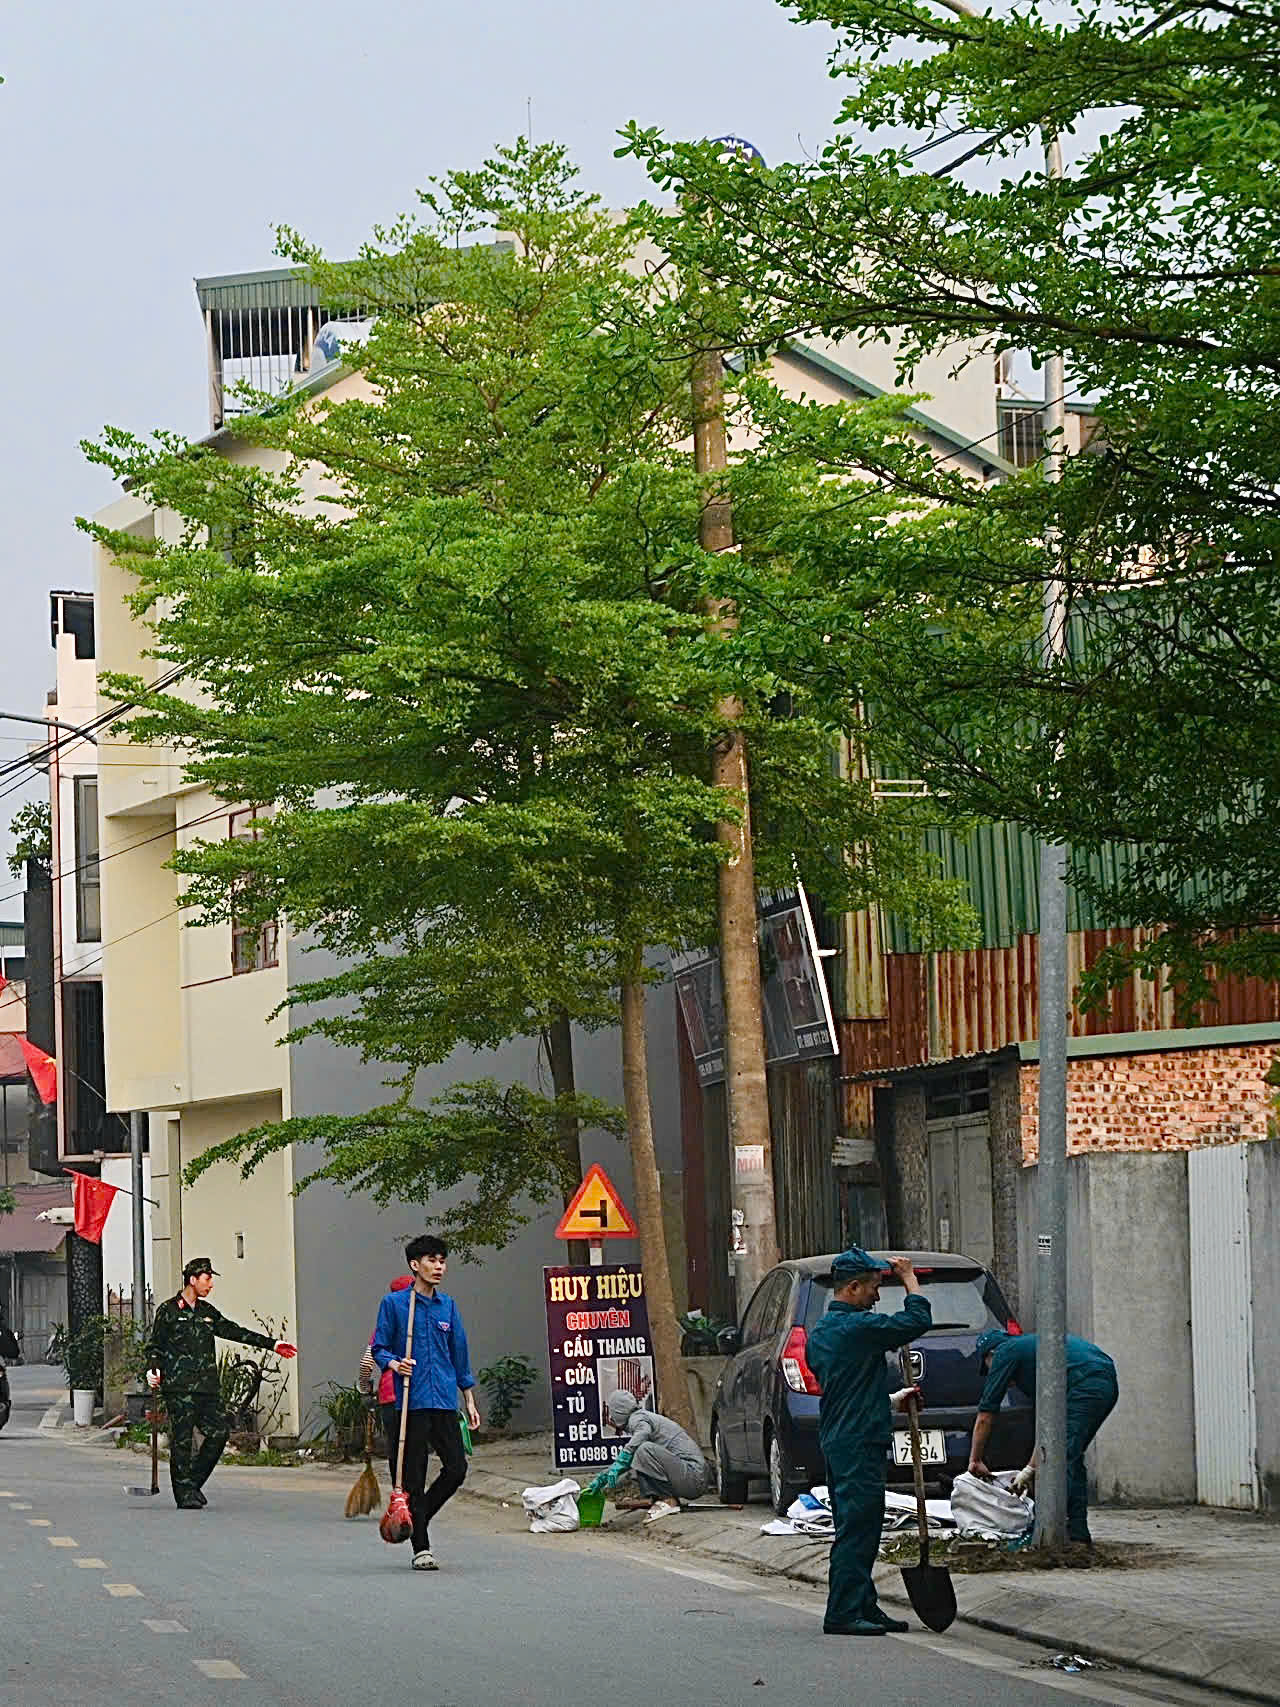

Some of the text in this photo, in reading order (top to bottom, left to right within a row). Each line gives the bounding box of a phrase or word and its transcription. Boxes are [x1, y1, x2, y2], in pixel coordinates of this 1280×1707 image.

[550, 1266, 642, 1305] HUY HIỆU
[566, 1307, 630, 1331] CHUYÊN
[563, 1333, 593, 1358] CẦU
[597, 1336, 646, 1356] THANG
[565, 1362, 595, 1386] CỬA
[566, 1390, 585, 1413] TỦ
[568, 1418, 598, 1442] BẾP
[904, 1431, 932, 1446] 3T
[559, 1447, 577, 1463] ĐT:
[580, 1445, 608, 1462] 0988
[900, 1446, 938, 1462] 794
